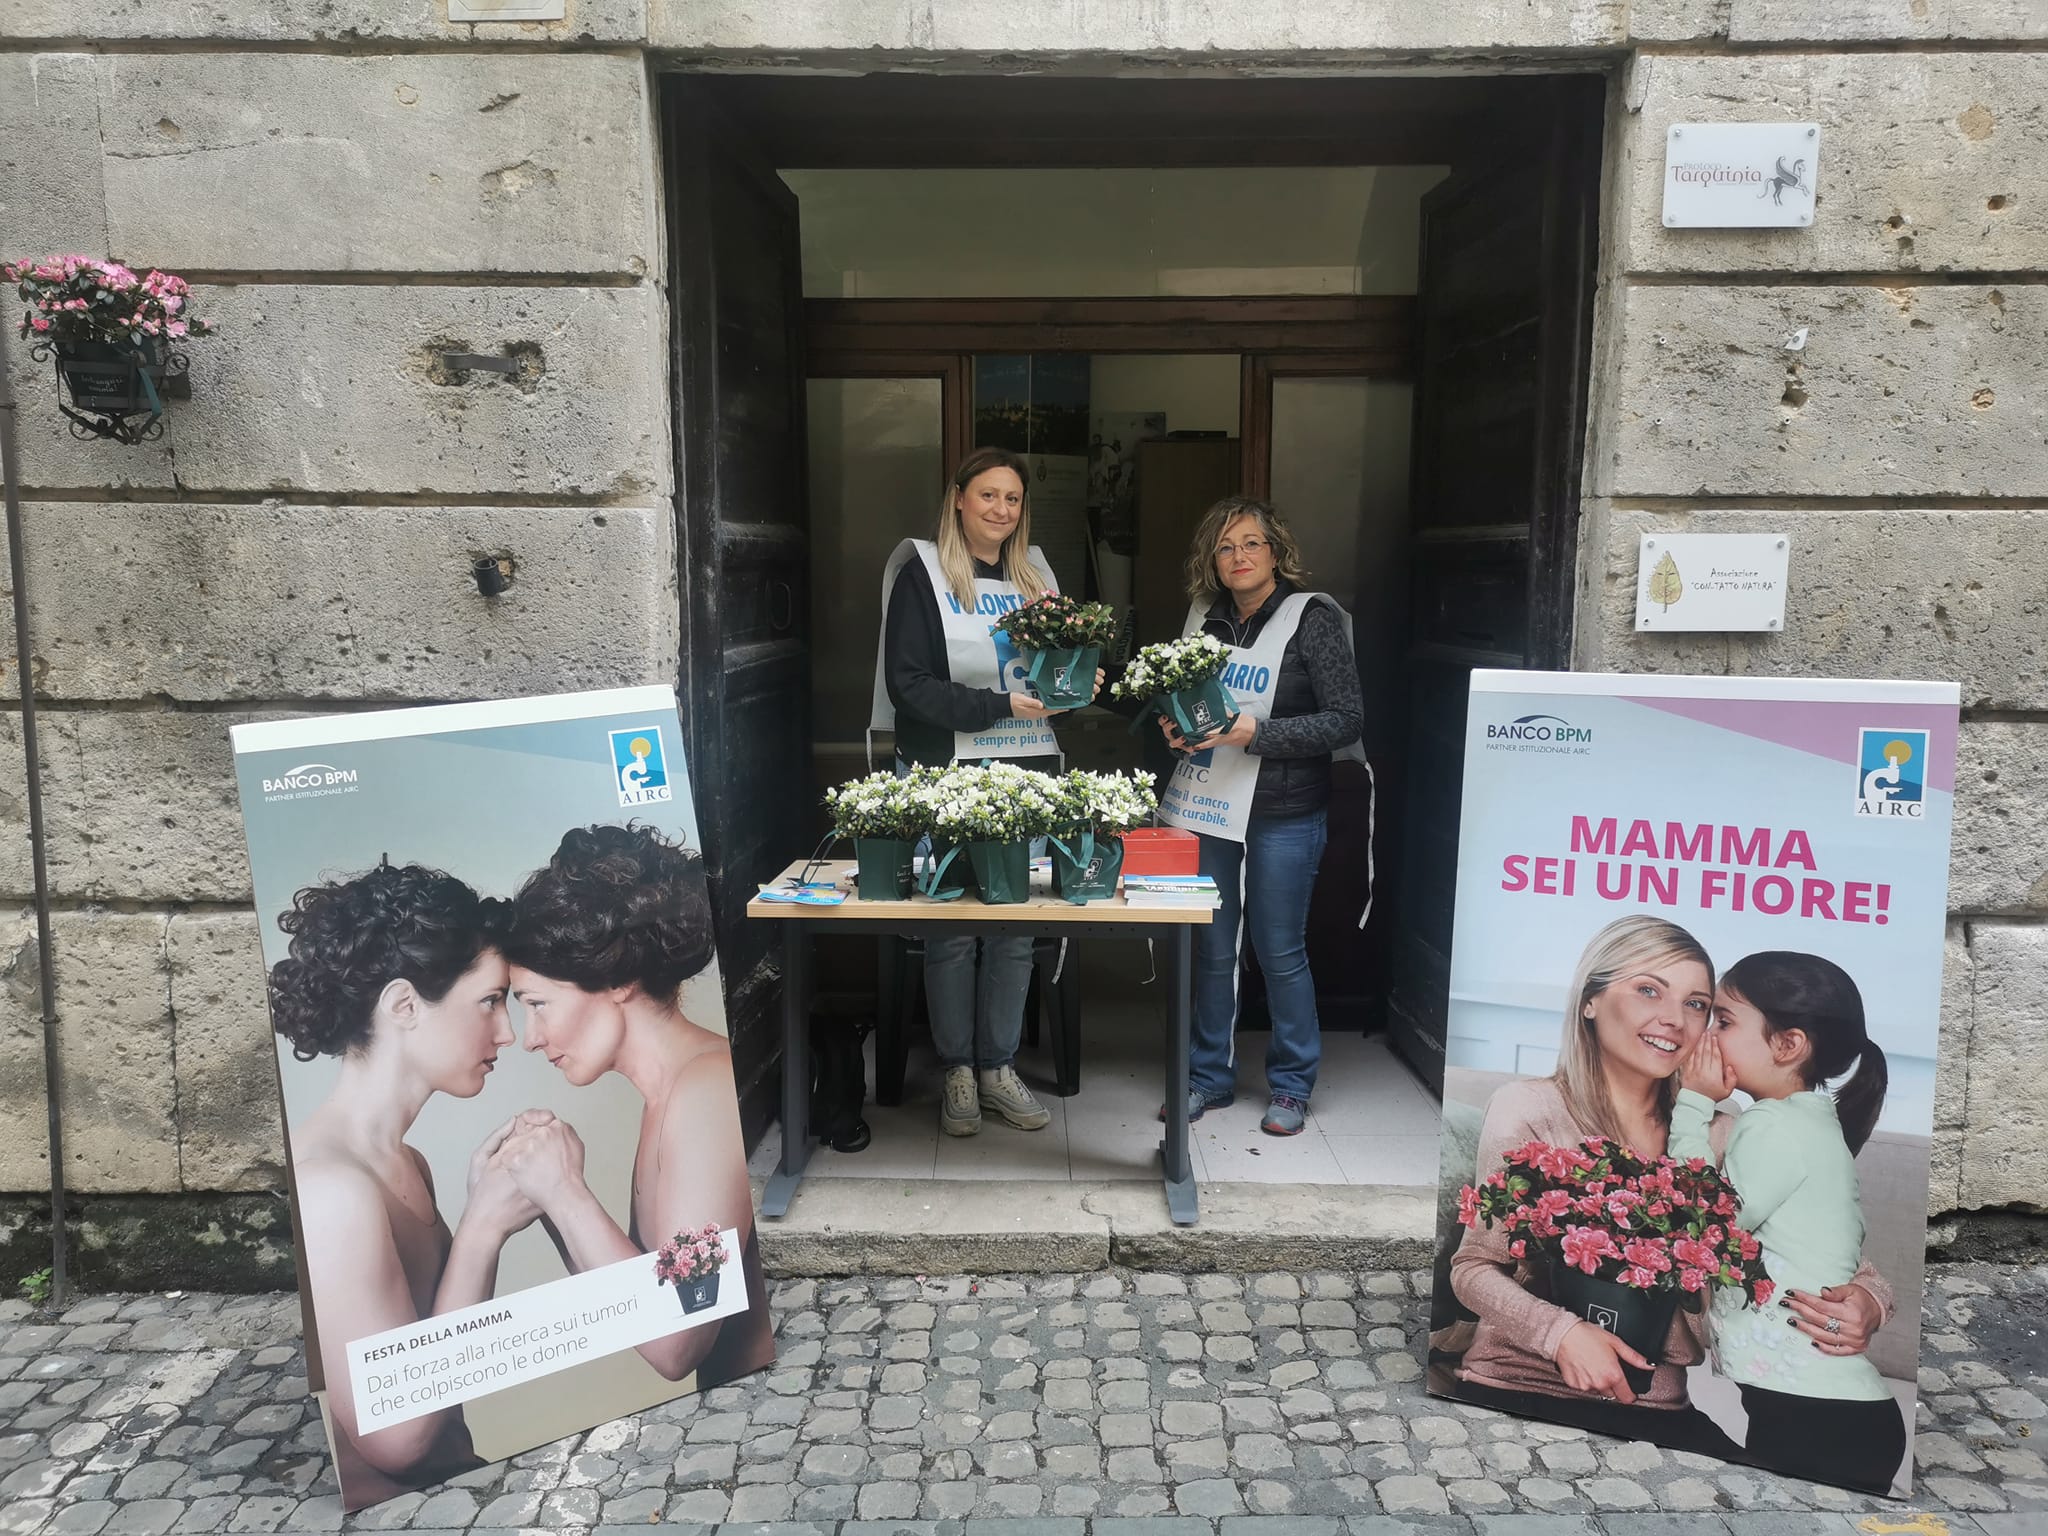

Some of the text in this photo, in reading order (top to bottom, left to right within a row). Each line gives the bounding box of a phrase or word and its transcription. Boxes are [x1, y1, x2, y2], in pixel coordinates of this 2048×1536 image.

[1671, 165, 1762, 188] Tarquinia
[1710, 568, 1759, 578] Associazione
[944, 591, 1026, 616] VLONT
[992, 717, 1033, 730] diamo
[973, 735, 1016, 748] sempre
[1020, 732, 1038, 748] più
[1487, 724, 1592, 742] BANCO BPM
[1486, 743, 1517, 752] PARTNER
[1519, 744, 1571, 755] ISTITUZIONALE
[262, 769, 358, 792] BANCO BPM
[264, 785, 360, 803] PARTNER ISTITUZIONALE AIRC
[623, 787, 669, 804] AIRC
[1192, 795, 1230, 811] cancro
[1182, 808, 1229, 827] curabile.
[1858, 801, 1922, 818] AIRC
[1569, 815, 1818, 871] MAMMA
[1501, 854, 1891, 926] SEI UN FIORE!
[364, 1310, 513, 1363] FESTA DELLA MAMMA
[367, 1294, 639, 1394] Dai forza alla ricerca sui tumori
[371, 1336, 588, 1416] che colpiscono le donne
